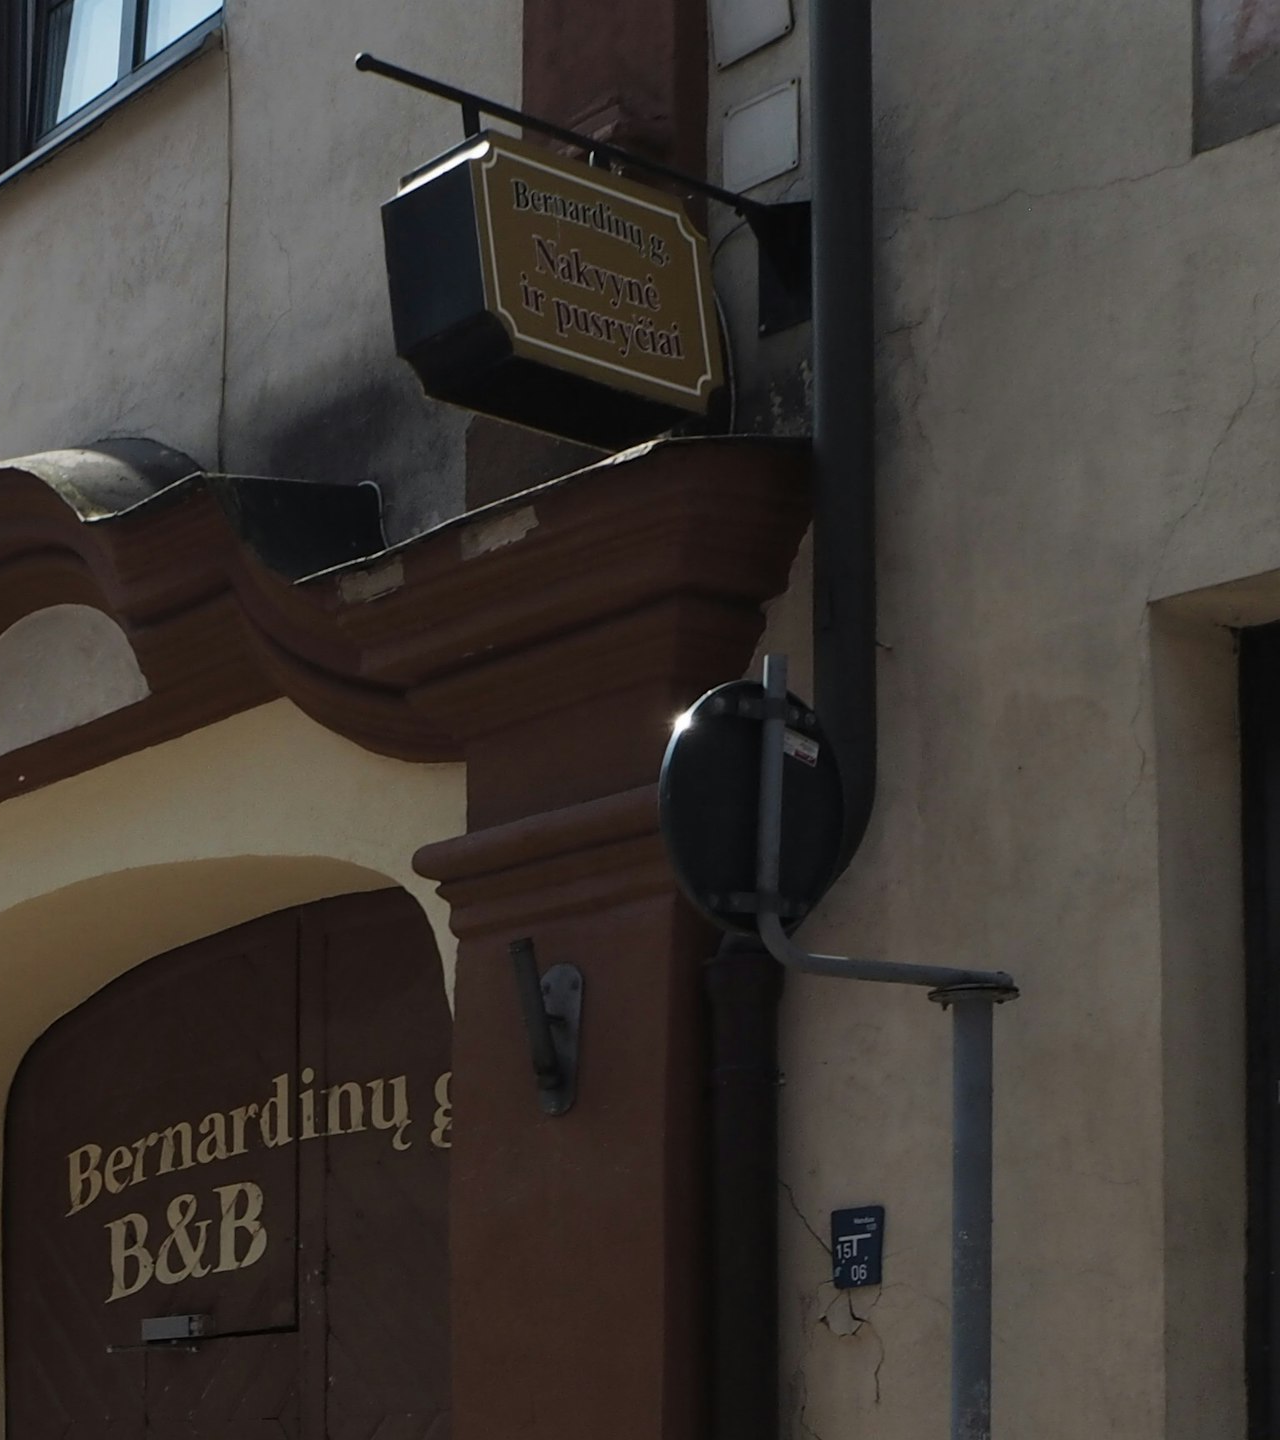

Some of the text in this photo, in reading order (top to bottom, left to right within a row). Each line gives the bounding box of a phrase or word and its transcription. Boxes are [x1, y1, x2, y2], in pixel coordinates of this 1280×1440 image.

[510, 178, 671, 268] Bernardinų g.
[520, 272, 686, 360] ir pusryčiai
[532, 234, 662, 312] Nakvynė
[64, 1066, 413, 1218] Bernardinų
[103, 1180, 268, 1304] B&B
